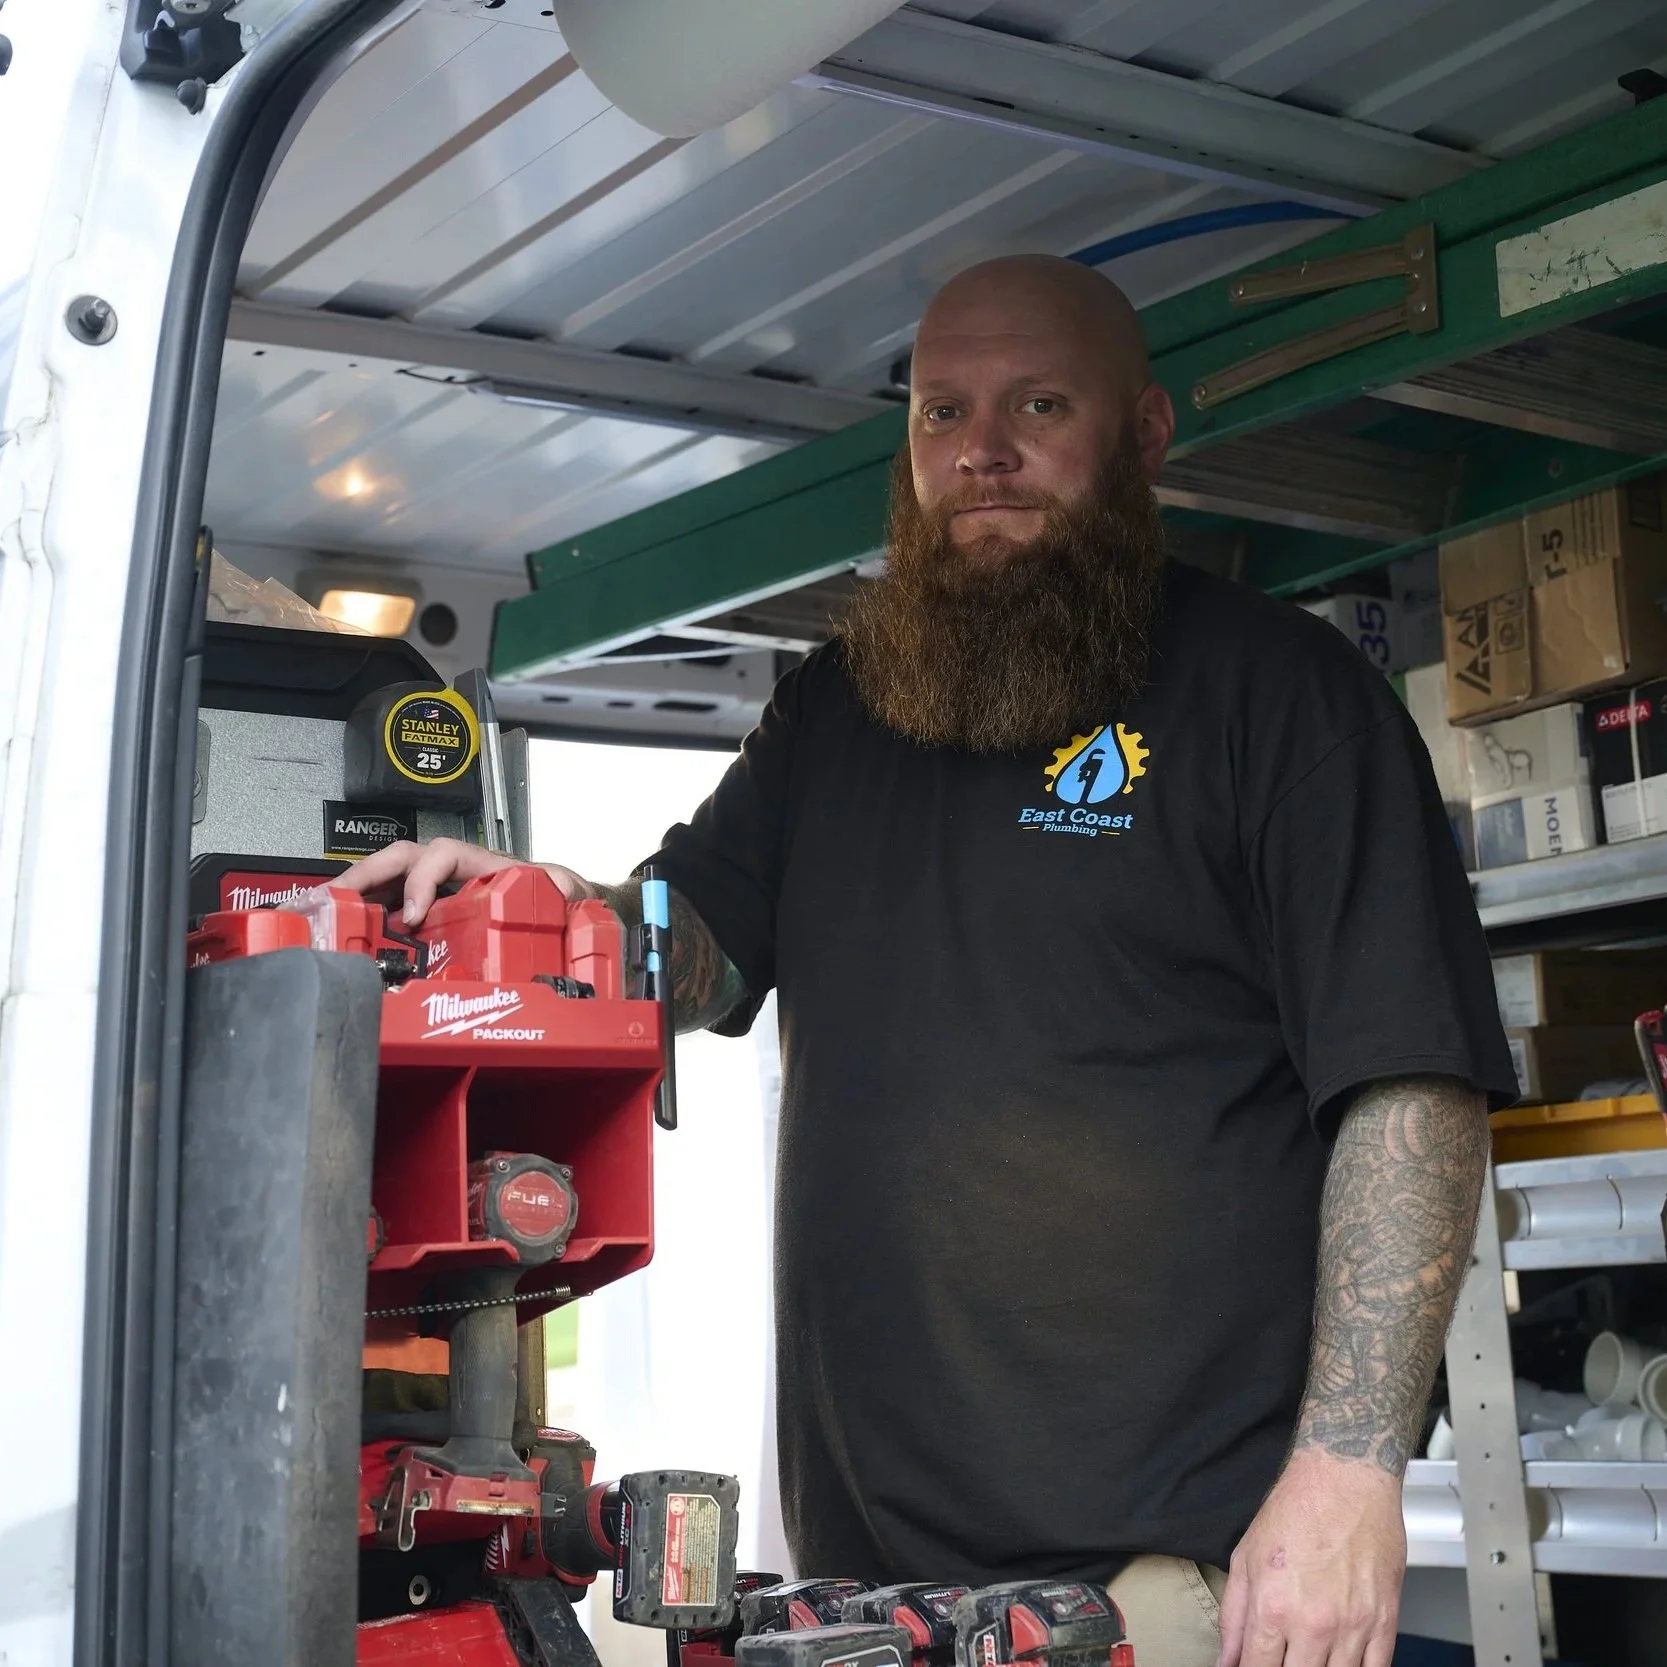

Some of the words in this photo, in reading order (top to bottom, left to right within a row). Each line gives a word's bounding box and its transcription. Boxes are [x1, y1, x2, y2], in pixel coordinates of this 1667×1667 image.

[402, 719, 460, 735] STANLEY
[405, 733, 457, 745] FATMAX
[417, 753, 446, 770] 25'
[1018, 808, 1065, 823] East
[1069, 808, 1133, 829] Coast
[335, 820, 398, 836] RANGER
[1042, 823, 1098, 837] Plumbing
[420, 987, 521, 1027] Milwaukee
[473, 1029, 545, 1041] PACKOUT
[508, 1191, 562, 1208] FUE
